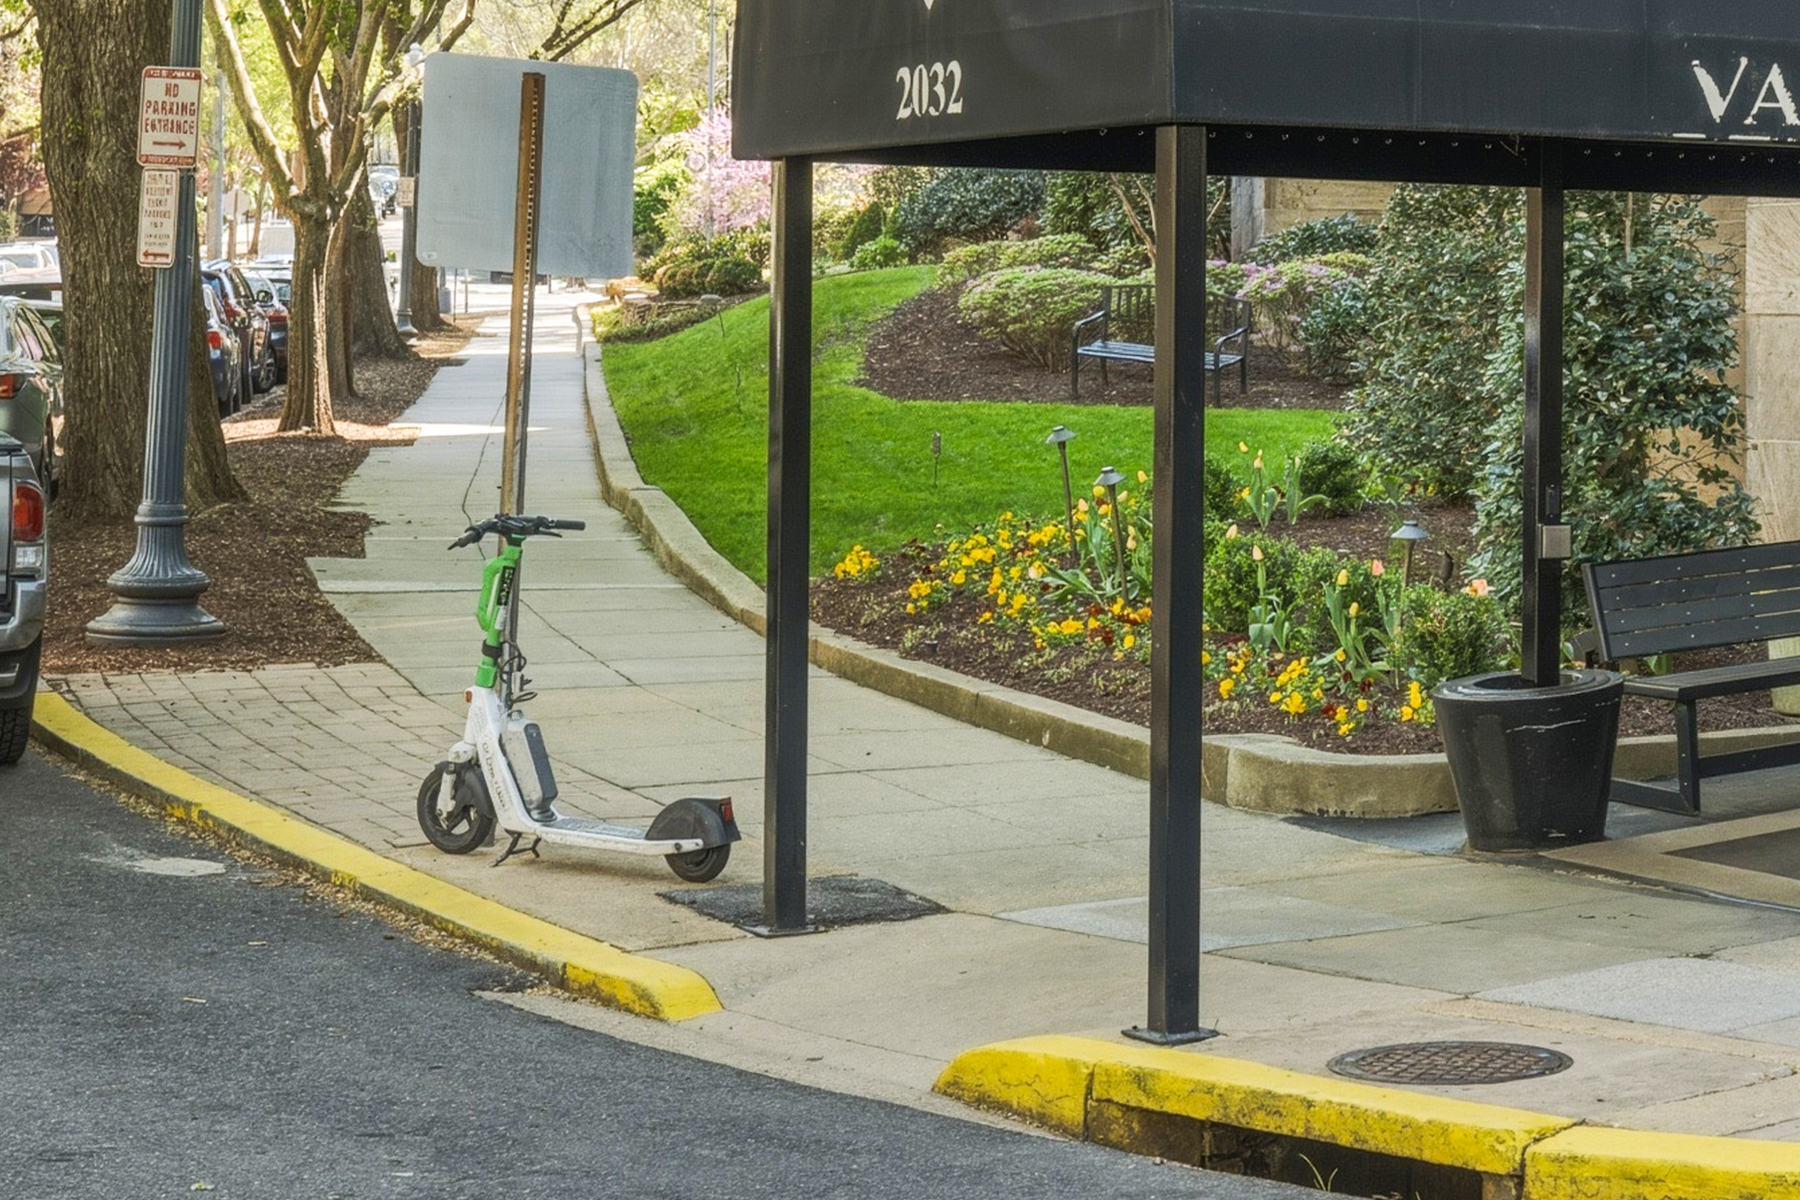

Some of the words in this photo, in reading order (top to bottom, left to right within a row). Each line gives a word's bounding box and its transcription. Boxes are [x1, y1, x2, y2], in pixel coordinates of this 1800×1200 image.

[164, 82, 179, 98] NO
[895, 59, 964, 121] 2032
[145, 100, 196, 117] PARKING
[144, 117, 195, 136] ENTRANCE
